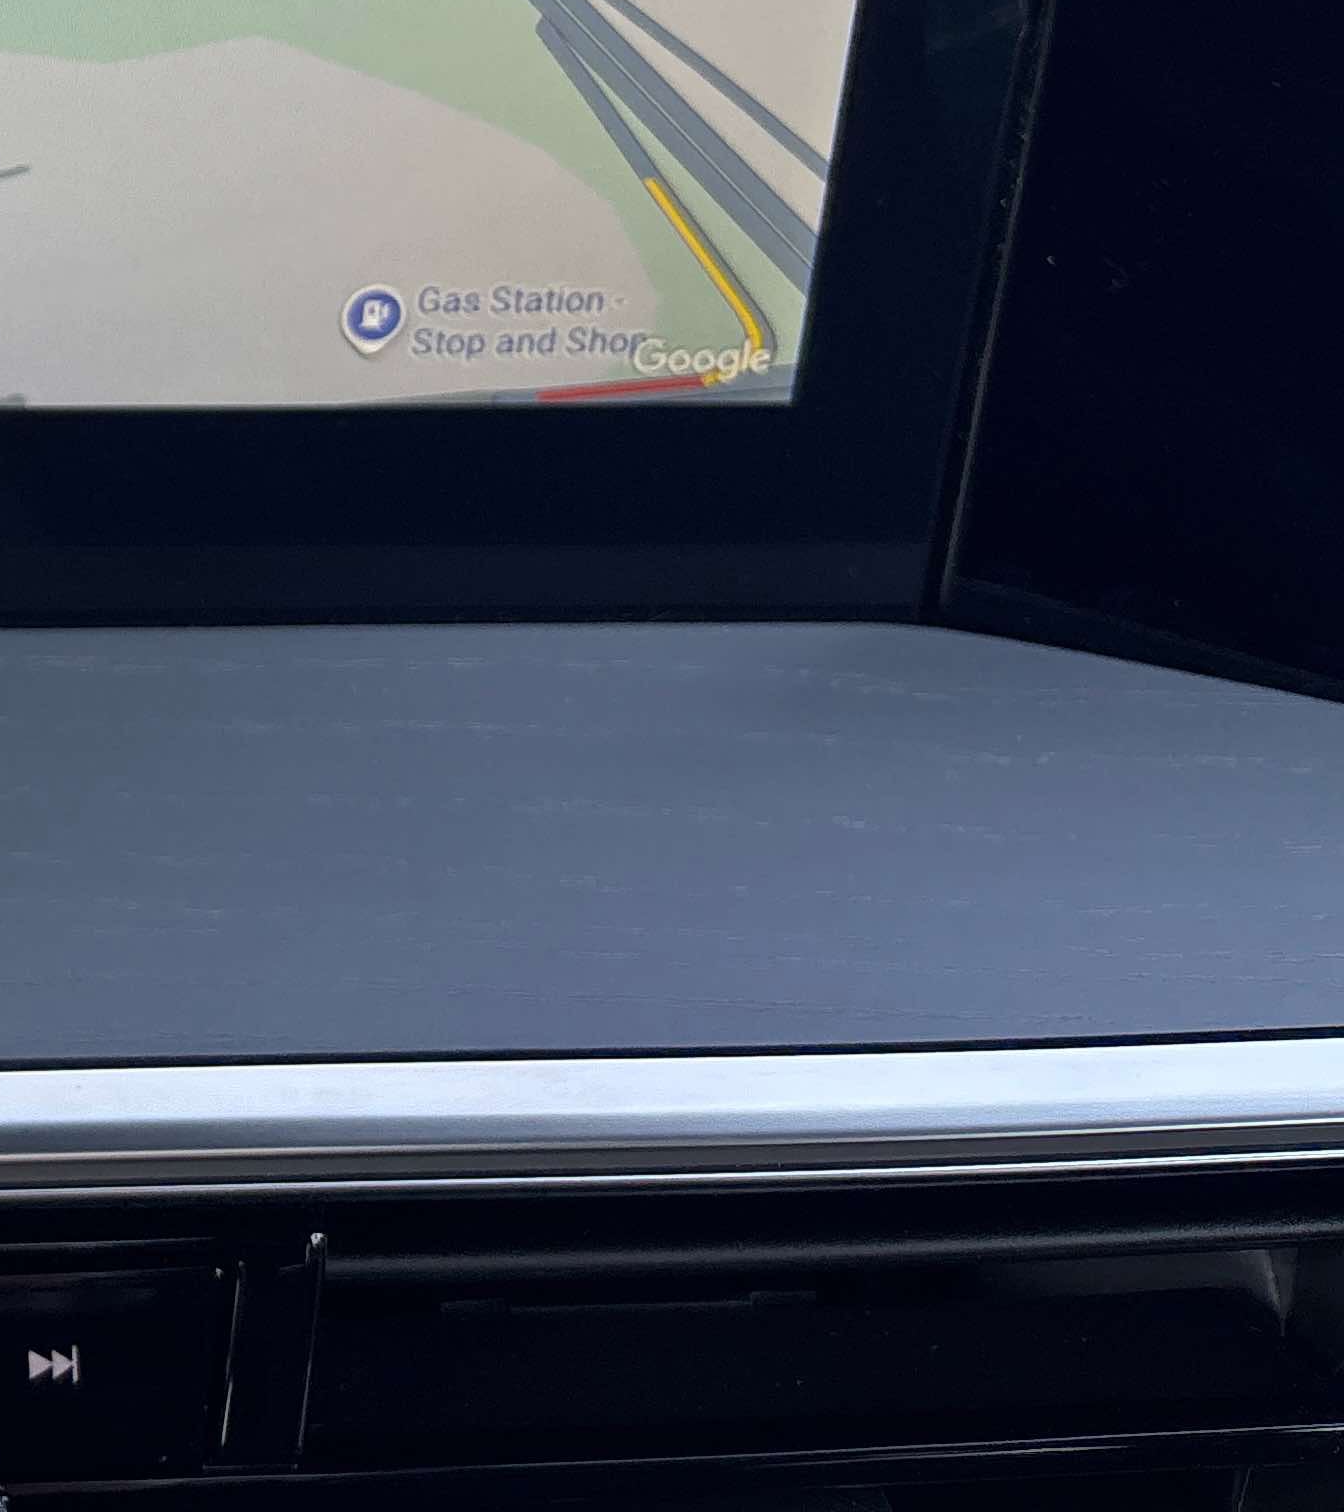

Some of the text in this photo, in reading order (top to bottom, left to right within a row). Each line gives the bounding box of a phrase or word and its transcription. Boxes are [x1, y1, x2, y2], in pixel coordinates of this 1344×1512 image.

[416, 285, 482, 315] Gas
[489, 284, 606, 314] Station
[412, 328, 486, 360] Stop
[496, 325, 558, 354] and
[633, 339, 771, 382] Google
